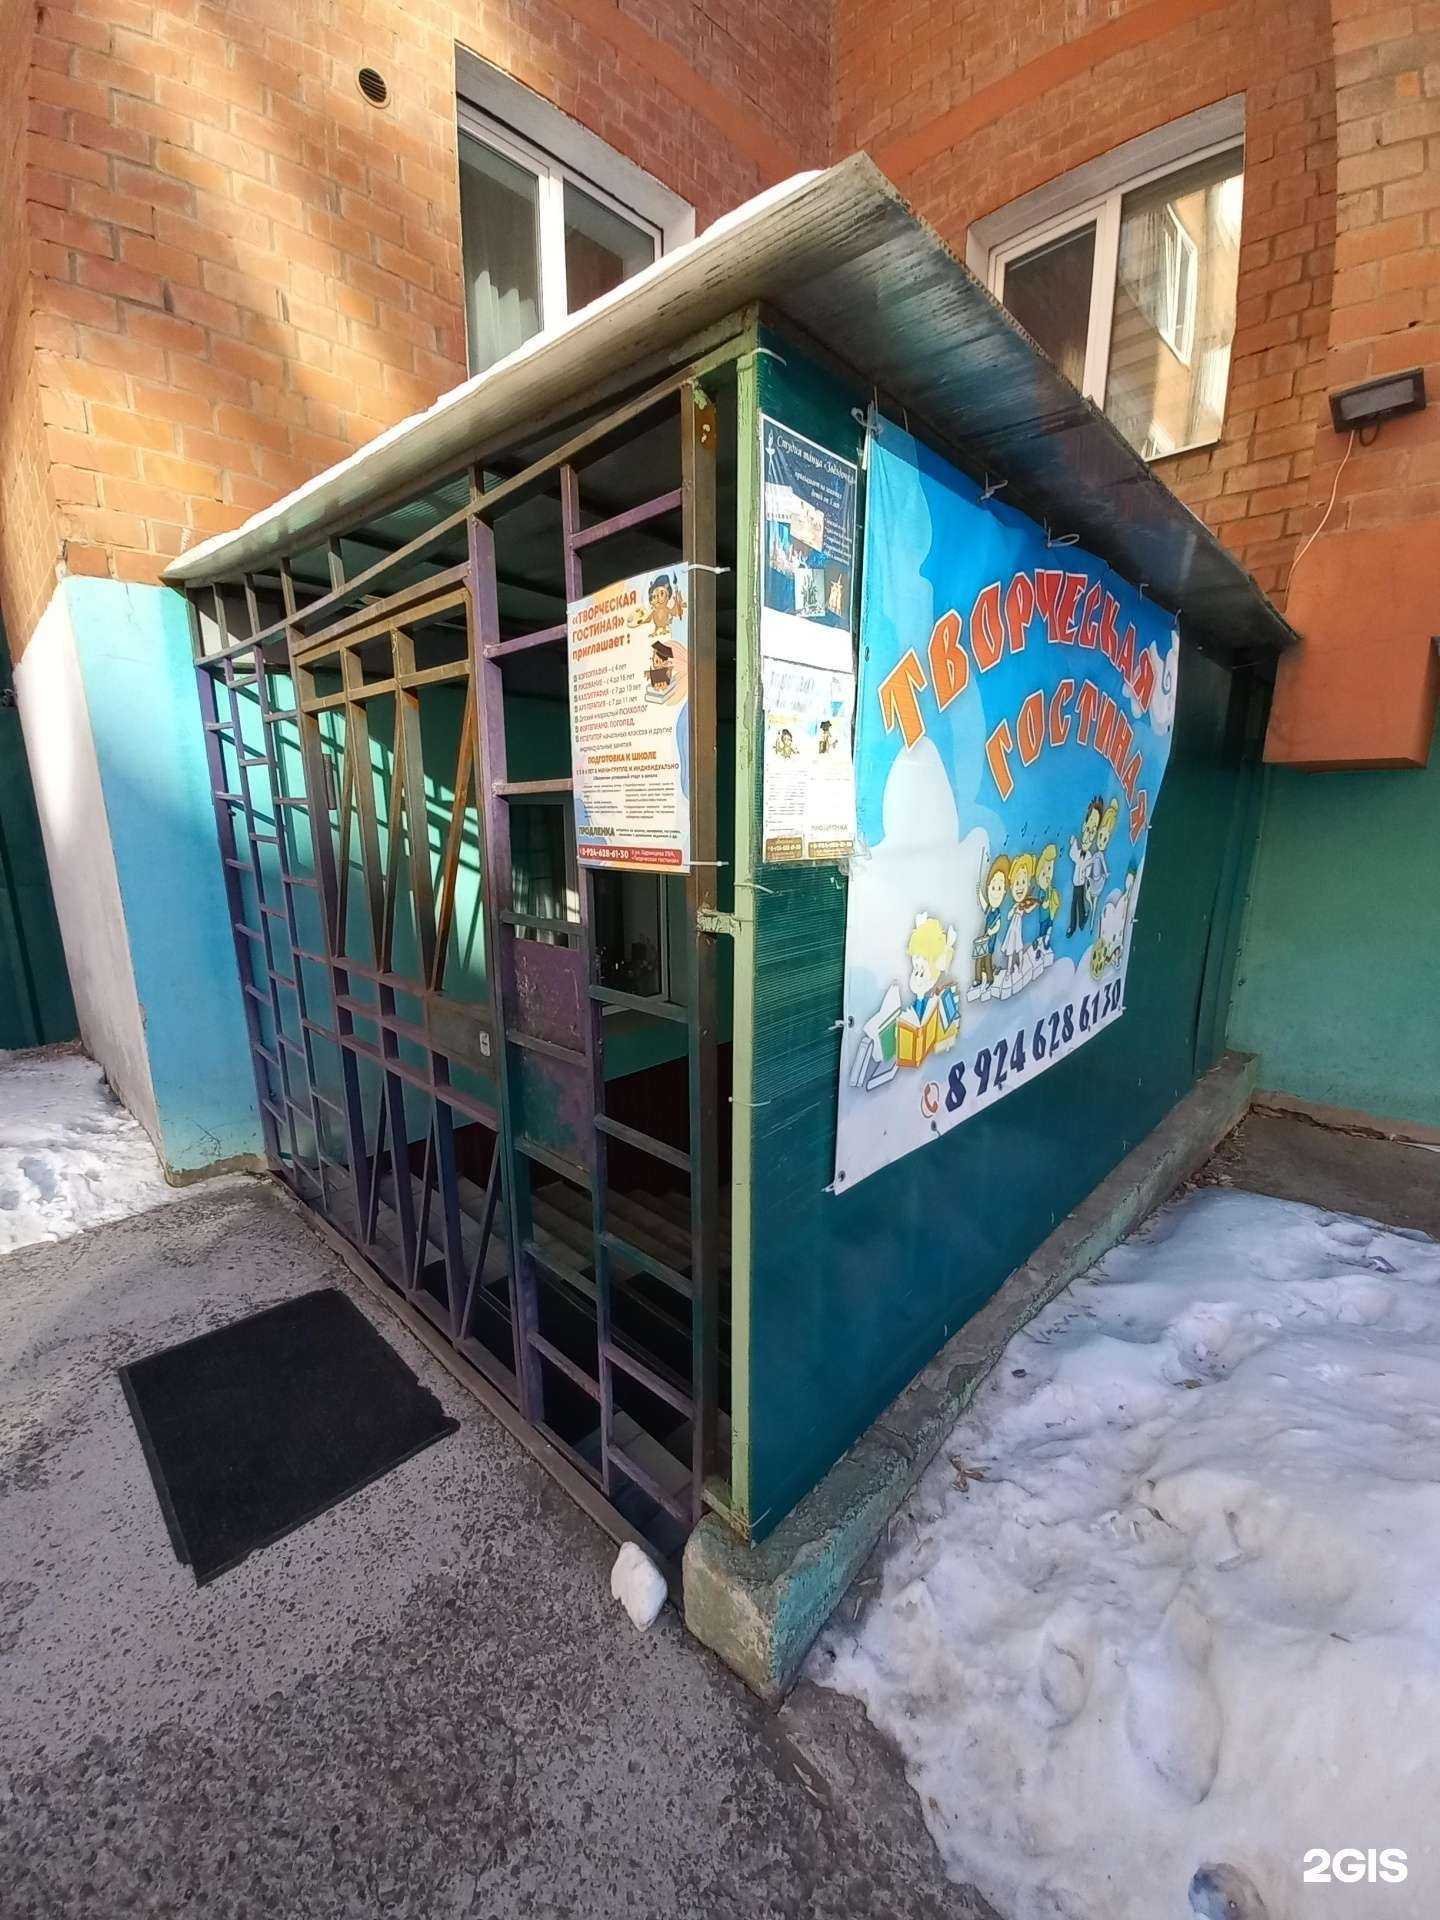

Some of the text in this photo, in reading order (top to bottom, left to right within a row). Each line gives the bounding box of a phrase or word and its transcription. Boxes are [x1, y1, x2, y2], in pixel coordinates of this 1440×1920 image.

[572, 590, 637, 625] «ТВОРЧЕСКАЯ
[572, 616, 625, 643] ГОСТИНАЯ»
[572, 636, 625, 661] приглашает
[877, 568, 1156, 752] ТВОРЧЕСКАЯ
[587, 751, 657, 765] ПОДГОТОВКА К ШКОЛЕ
[985, 678, 1148, 846] ГОСТИНАЯ
[945, 978, 1121, 1112] 8 924 628 6130
